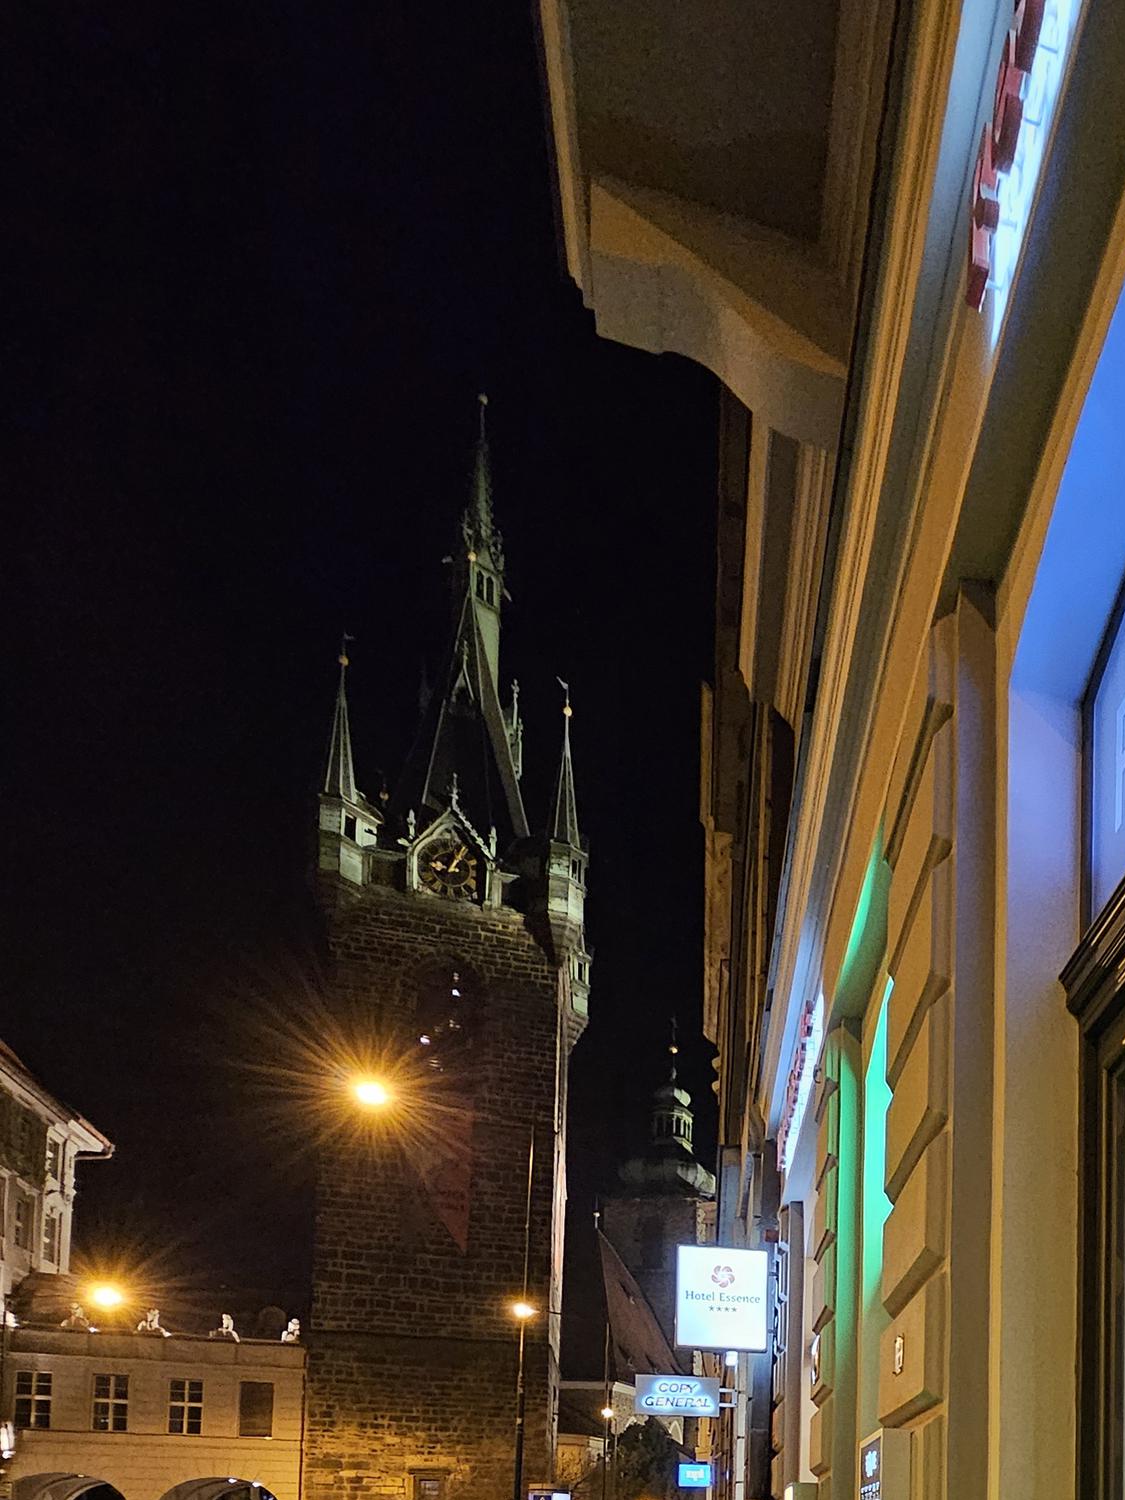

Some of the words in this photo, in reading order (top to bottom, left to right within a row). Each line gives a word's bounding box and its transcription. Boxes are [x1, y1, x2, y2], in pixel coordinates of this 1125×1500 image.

[684, 1290, 715, 1302] Hotel
[719, 1292, 761, 1304] Essence
[658, 1382, 698, 1394] COPY
[644, 1395, 711, 1408] GENERAL
